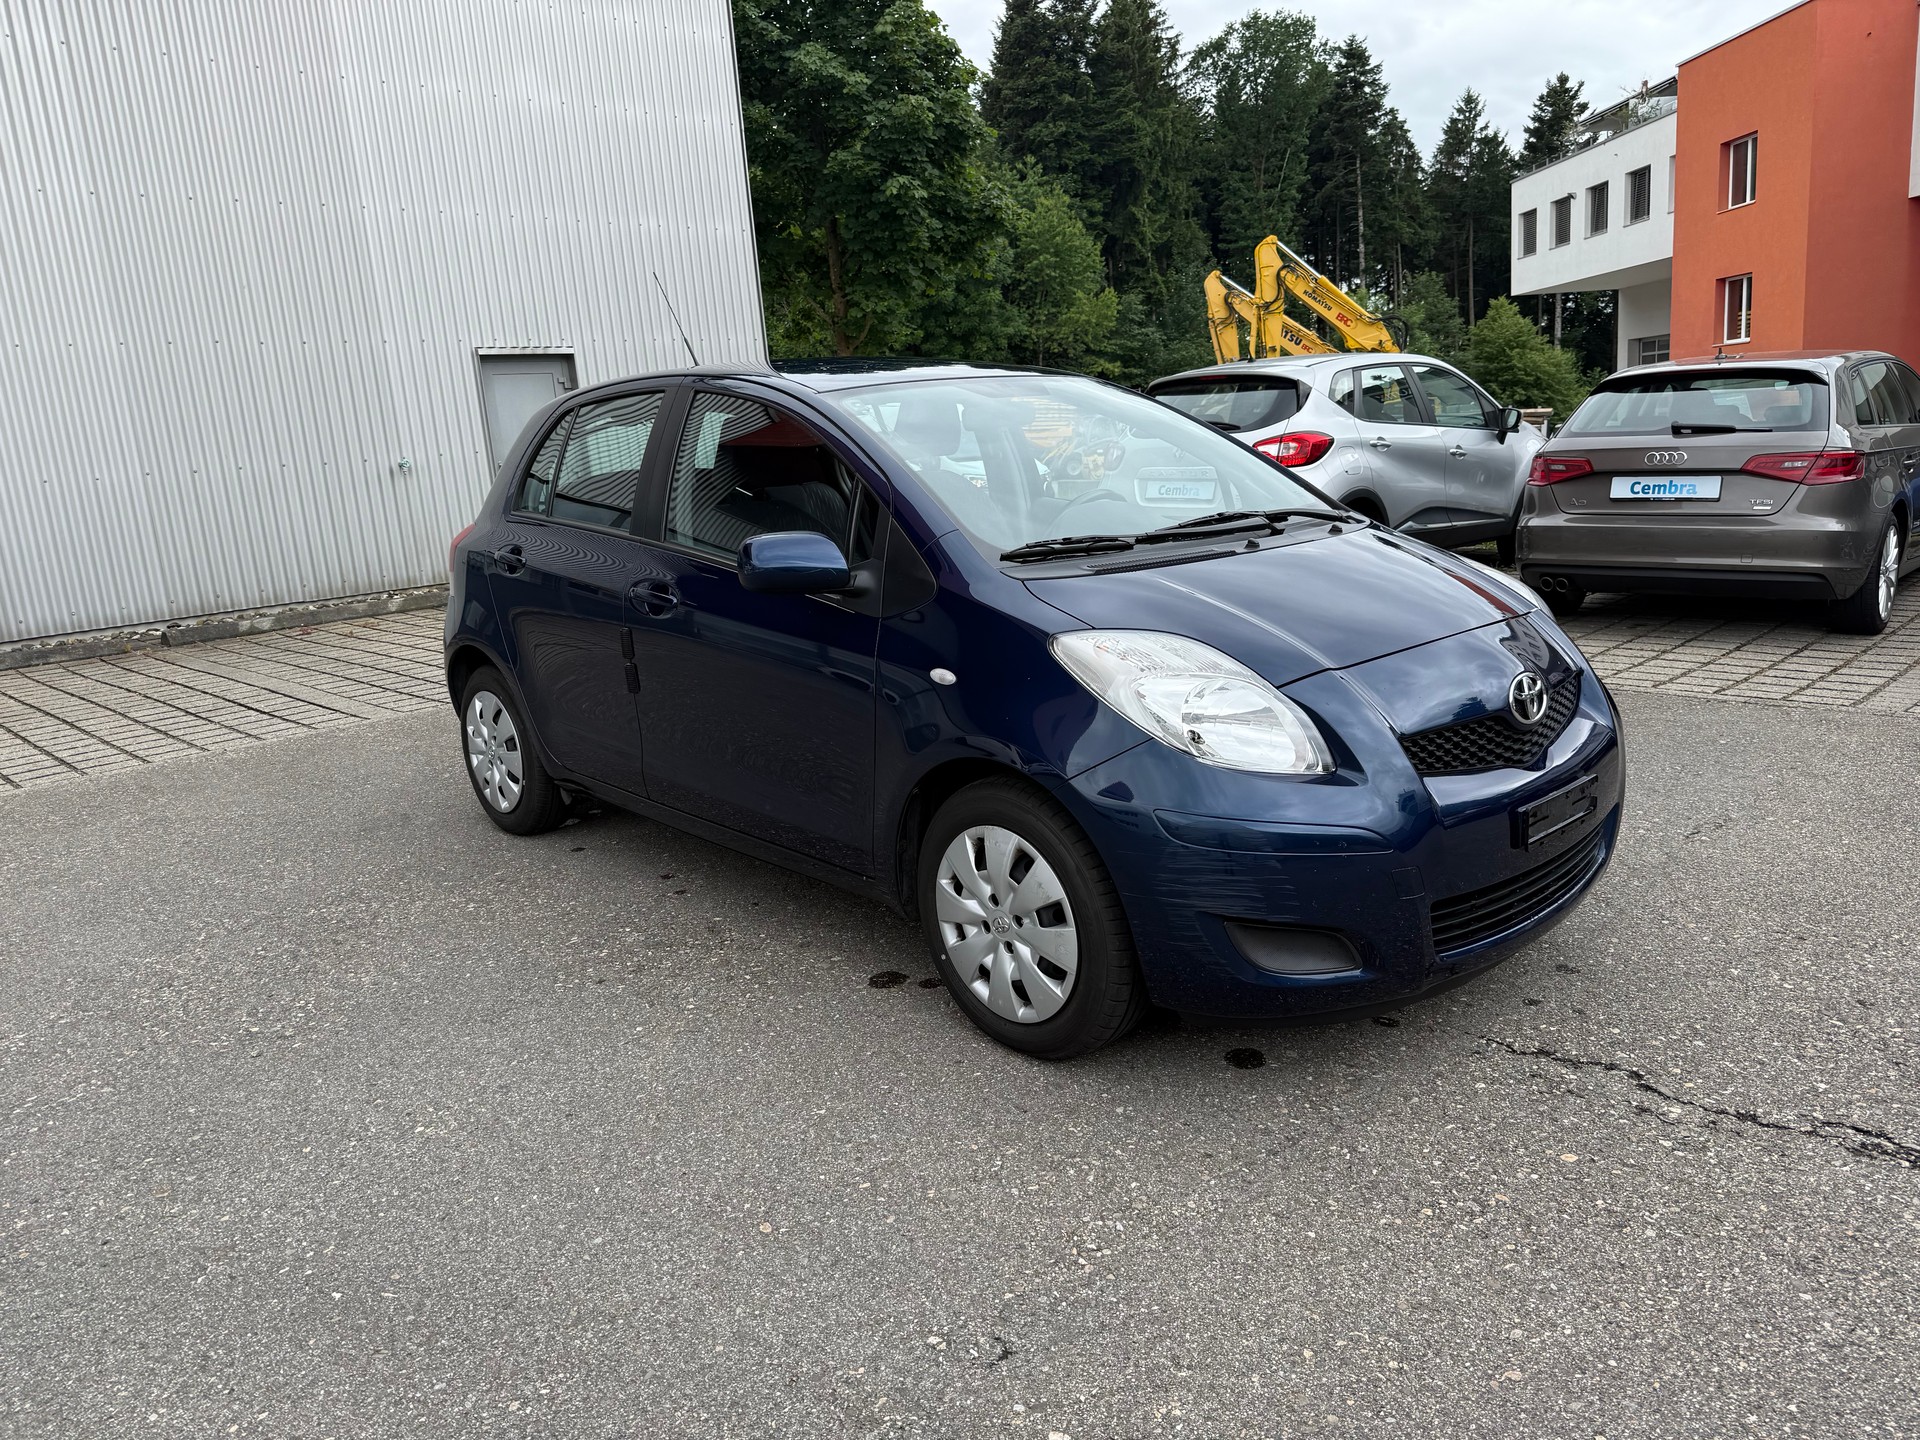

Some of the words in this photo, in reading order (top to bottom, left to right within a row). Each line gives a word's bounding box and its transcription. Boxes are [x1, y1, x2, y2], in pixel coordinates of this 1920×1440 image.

[1302, 289, 1333, 311] KOMATSU
[1335, 312, 1353, 327] BRC
[1281, 327, 1303, 346] TSU
[1158, 484, 1200, 496] Cembra
[1629, 480, 1698, 495] Cembra
